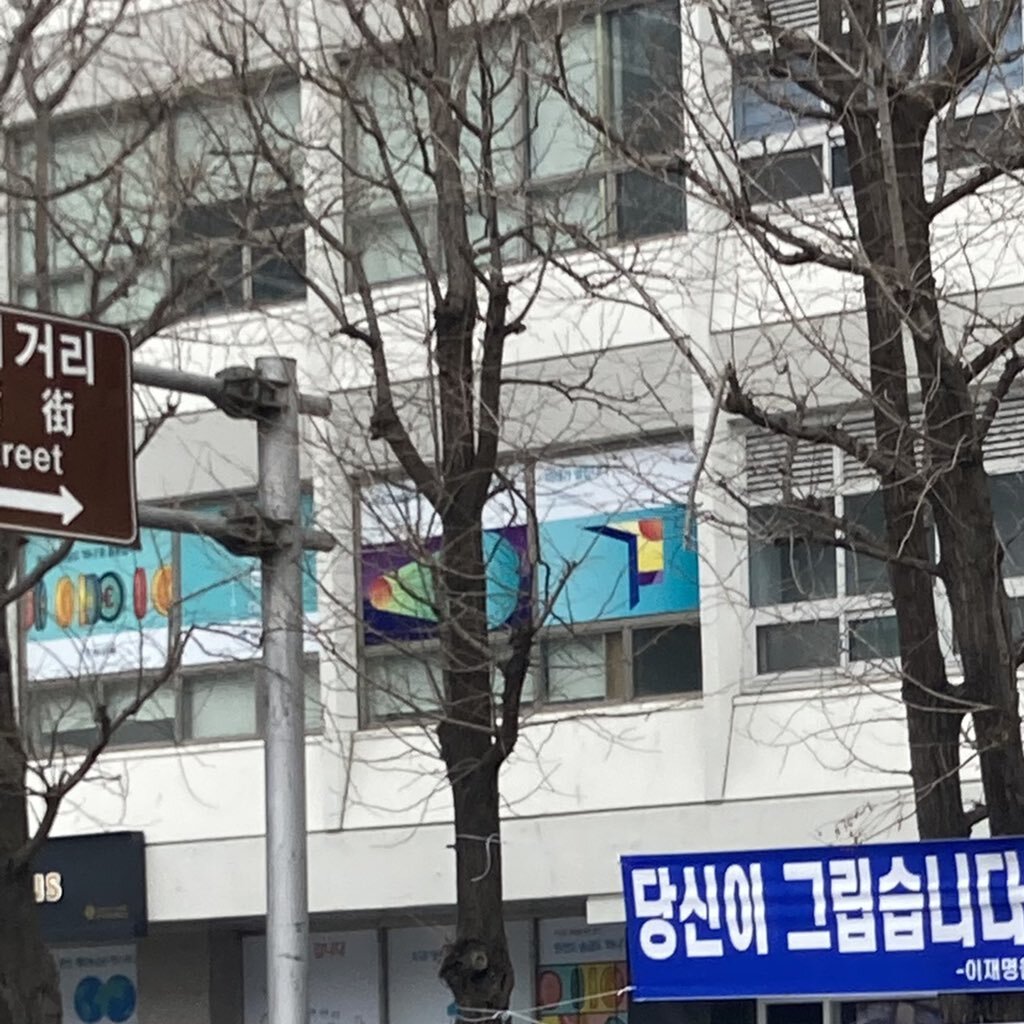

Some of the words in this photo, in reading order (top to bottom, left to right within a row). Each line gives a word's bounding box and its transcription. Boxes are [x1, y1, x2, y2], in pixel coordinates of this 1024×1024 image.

[15, 322, 94, 385] 거리
[41, 388, 75, 436] 街
[632, 864, 767, 959] 당신이
